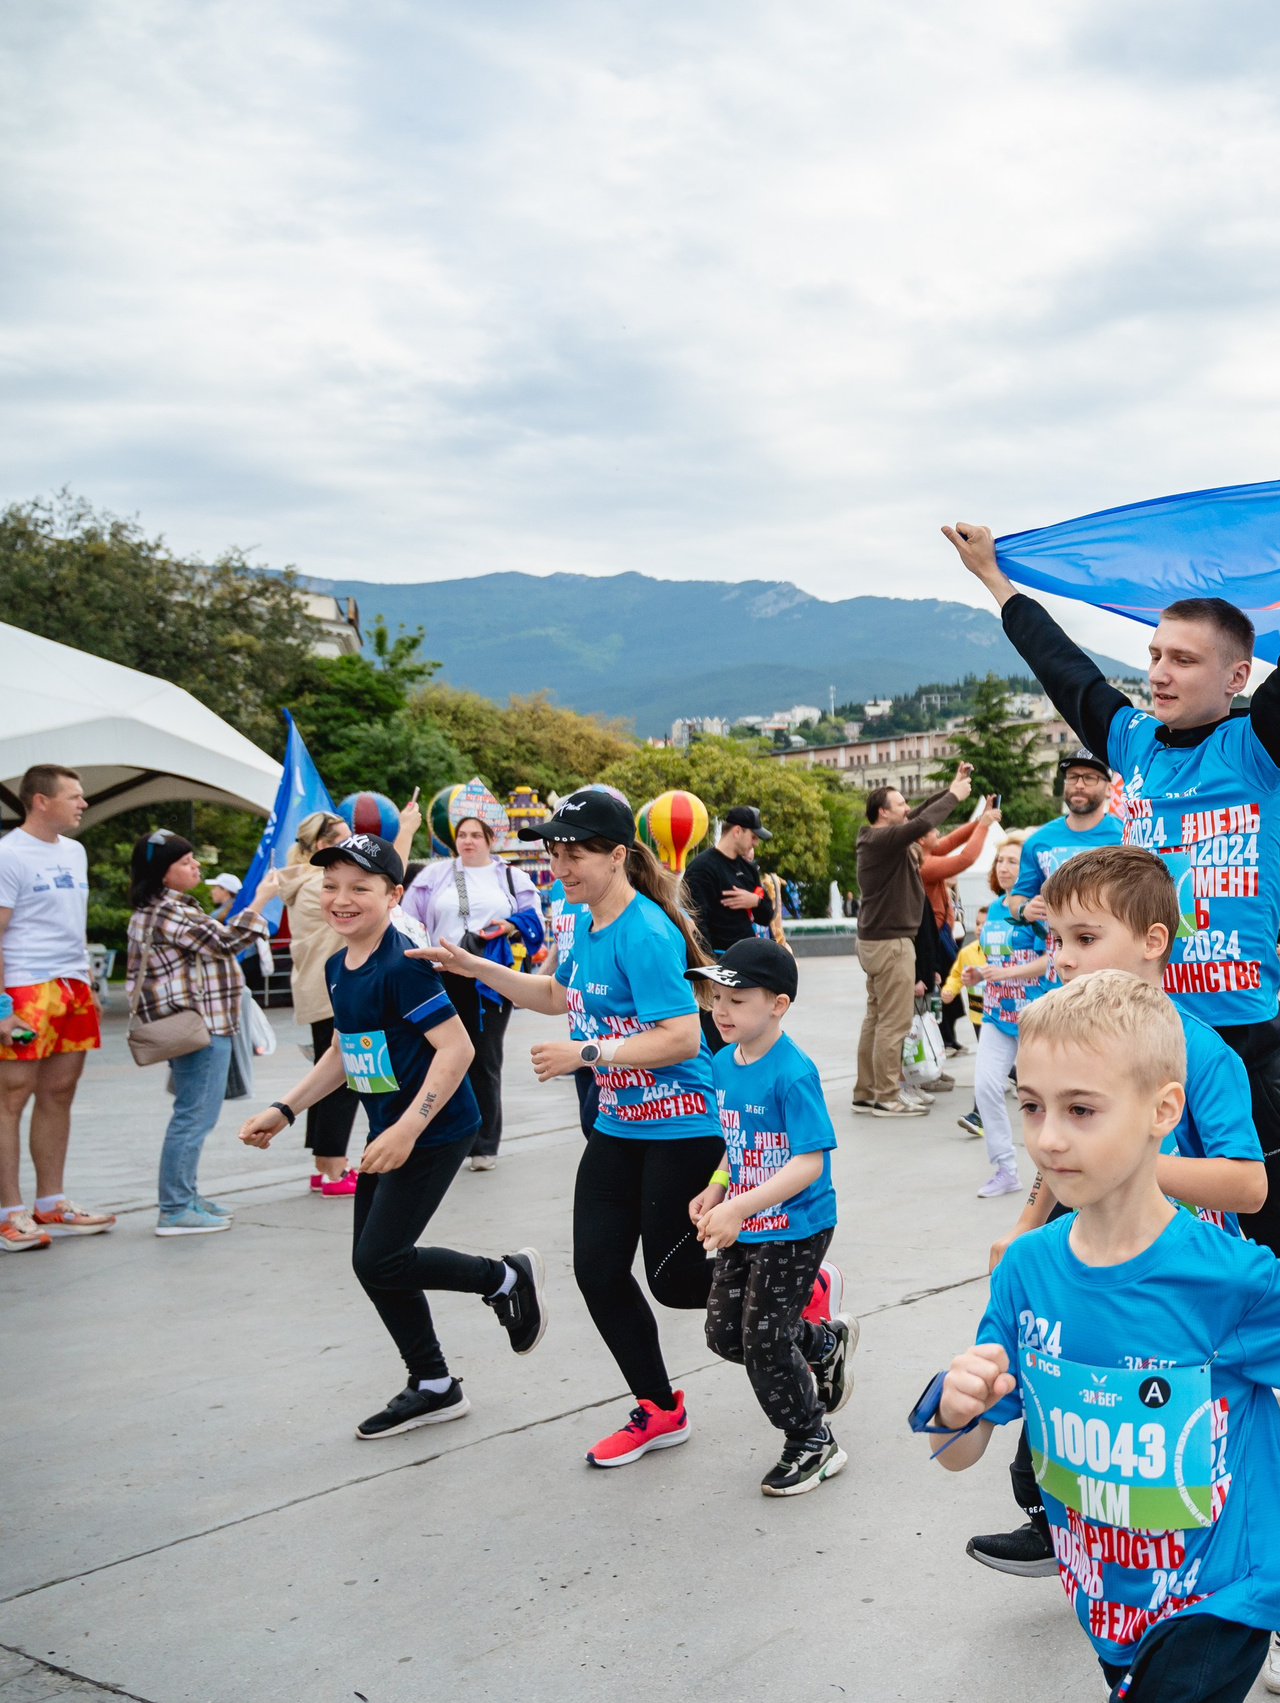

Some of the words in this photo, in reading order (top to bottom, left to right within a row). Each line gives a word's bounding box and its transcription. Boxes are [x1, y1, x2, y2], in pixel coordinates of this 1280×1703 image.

[1181, 803, 1261, 844] #ЦЕЛЬ
[1182, 930, 1242, 961] 2024
[1162, 960, 1261, 994] ДИНСТВО
[755, 1131, 790, 1149] #ЦЕЛ
[764, 1149, 793, 1167] 202
[1038, 1358, 1061, 1378] ПСБ
[1050, 1406, 1166, 1480] 10043
